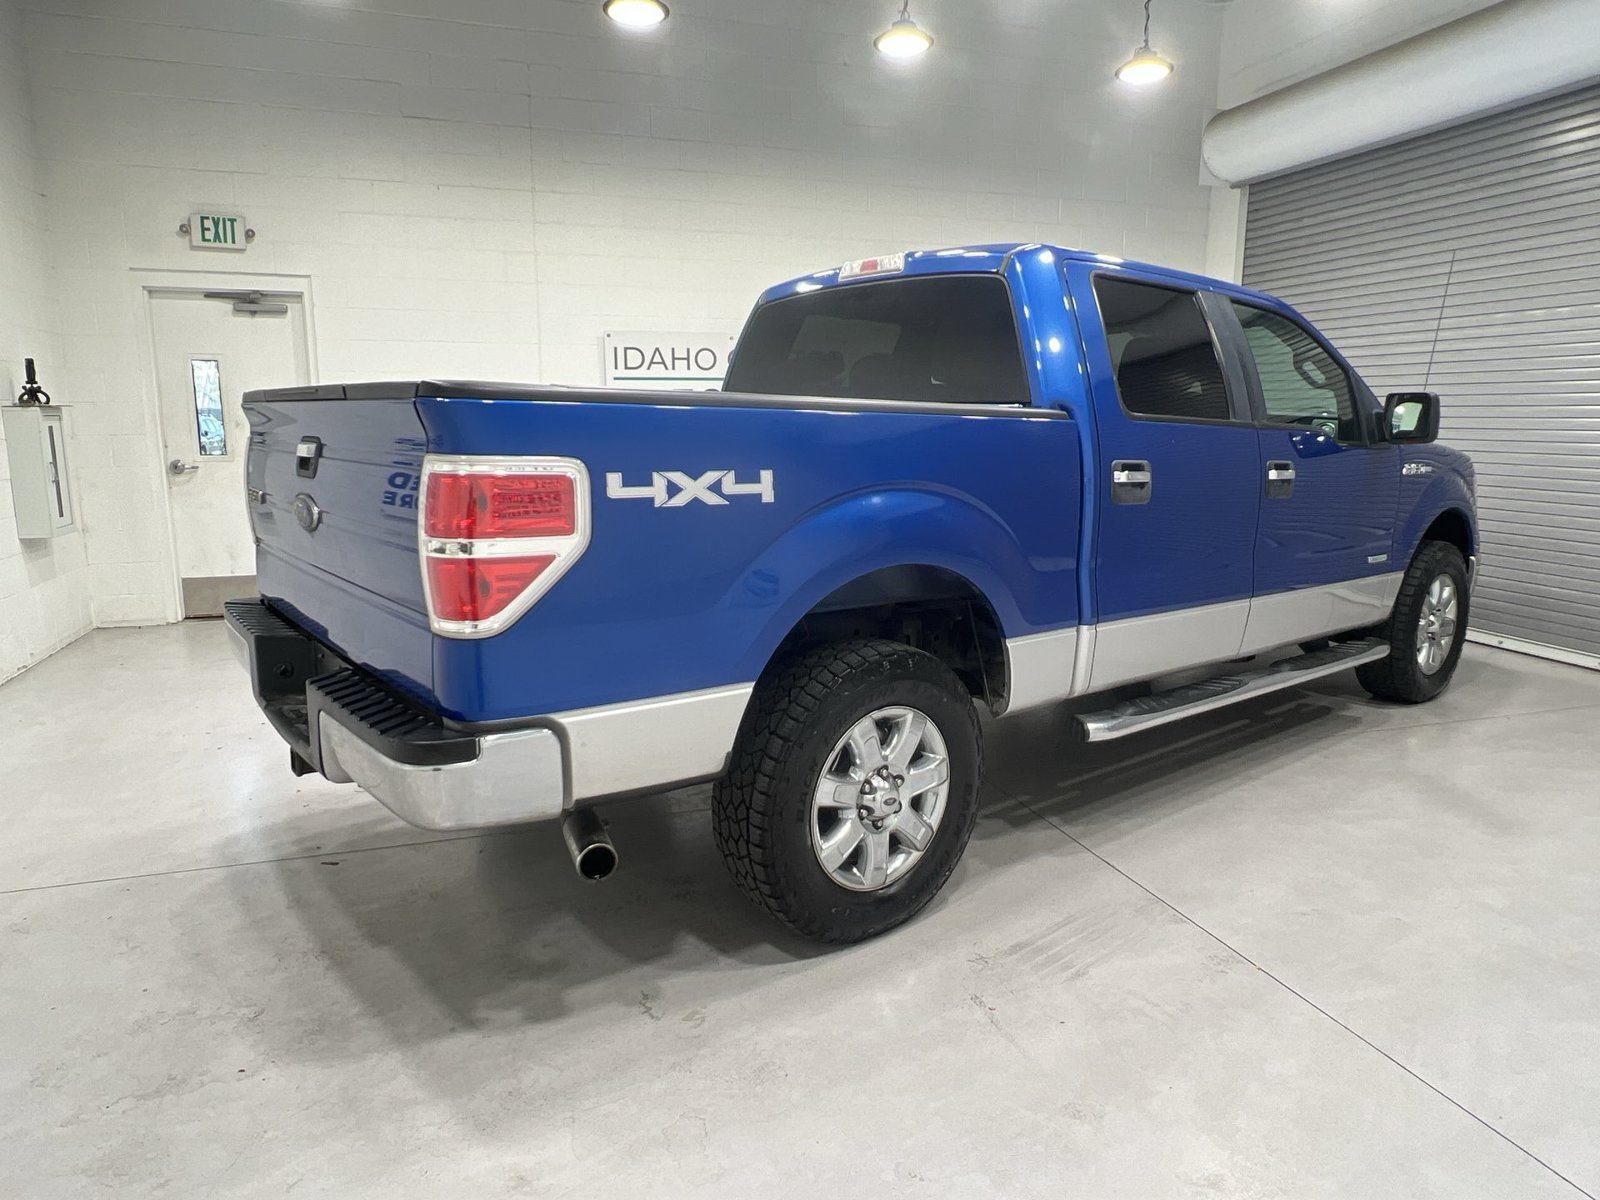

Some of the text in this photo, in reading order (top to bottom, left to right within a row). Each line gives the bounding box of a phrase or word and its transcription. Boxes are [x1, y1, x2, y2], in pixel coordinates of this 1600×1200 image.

[200, 215, 238, 245] EXIT
[613, 346, 718, 371] IDAHO
[605, 469, 775, 508] 4X4
